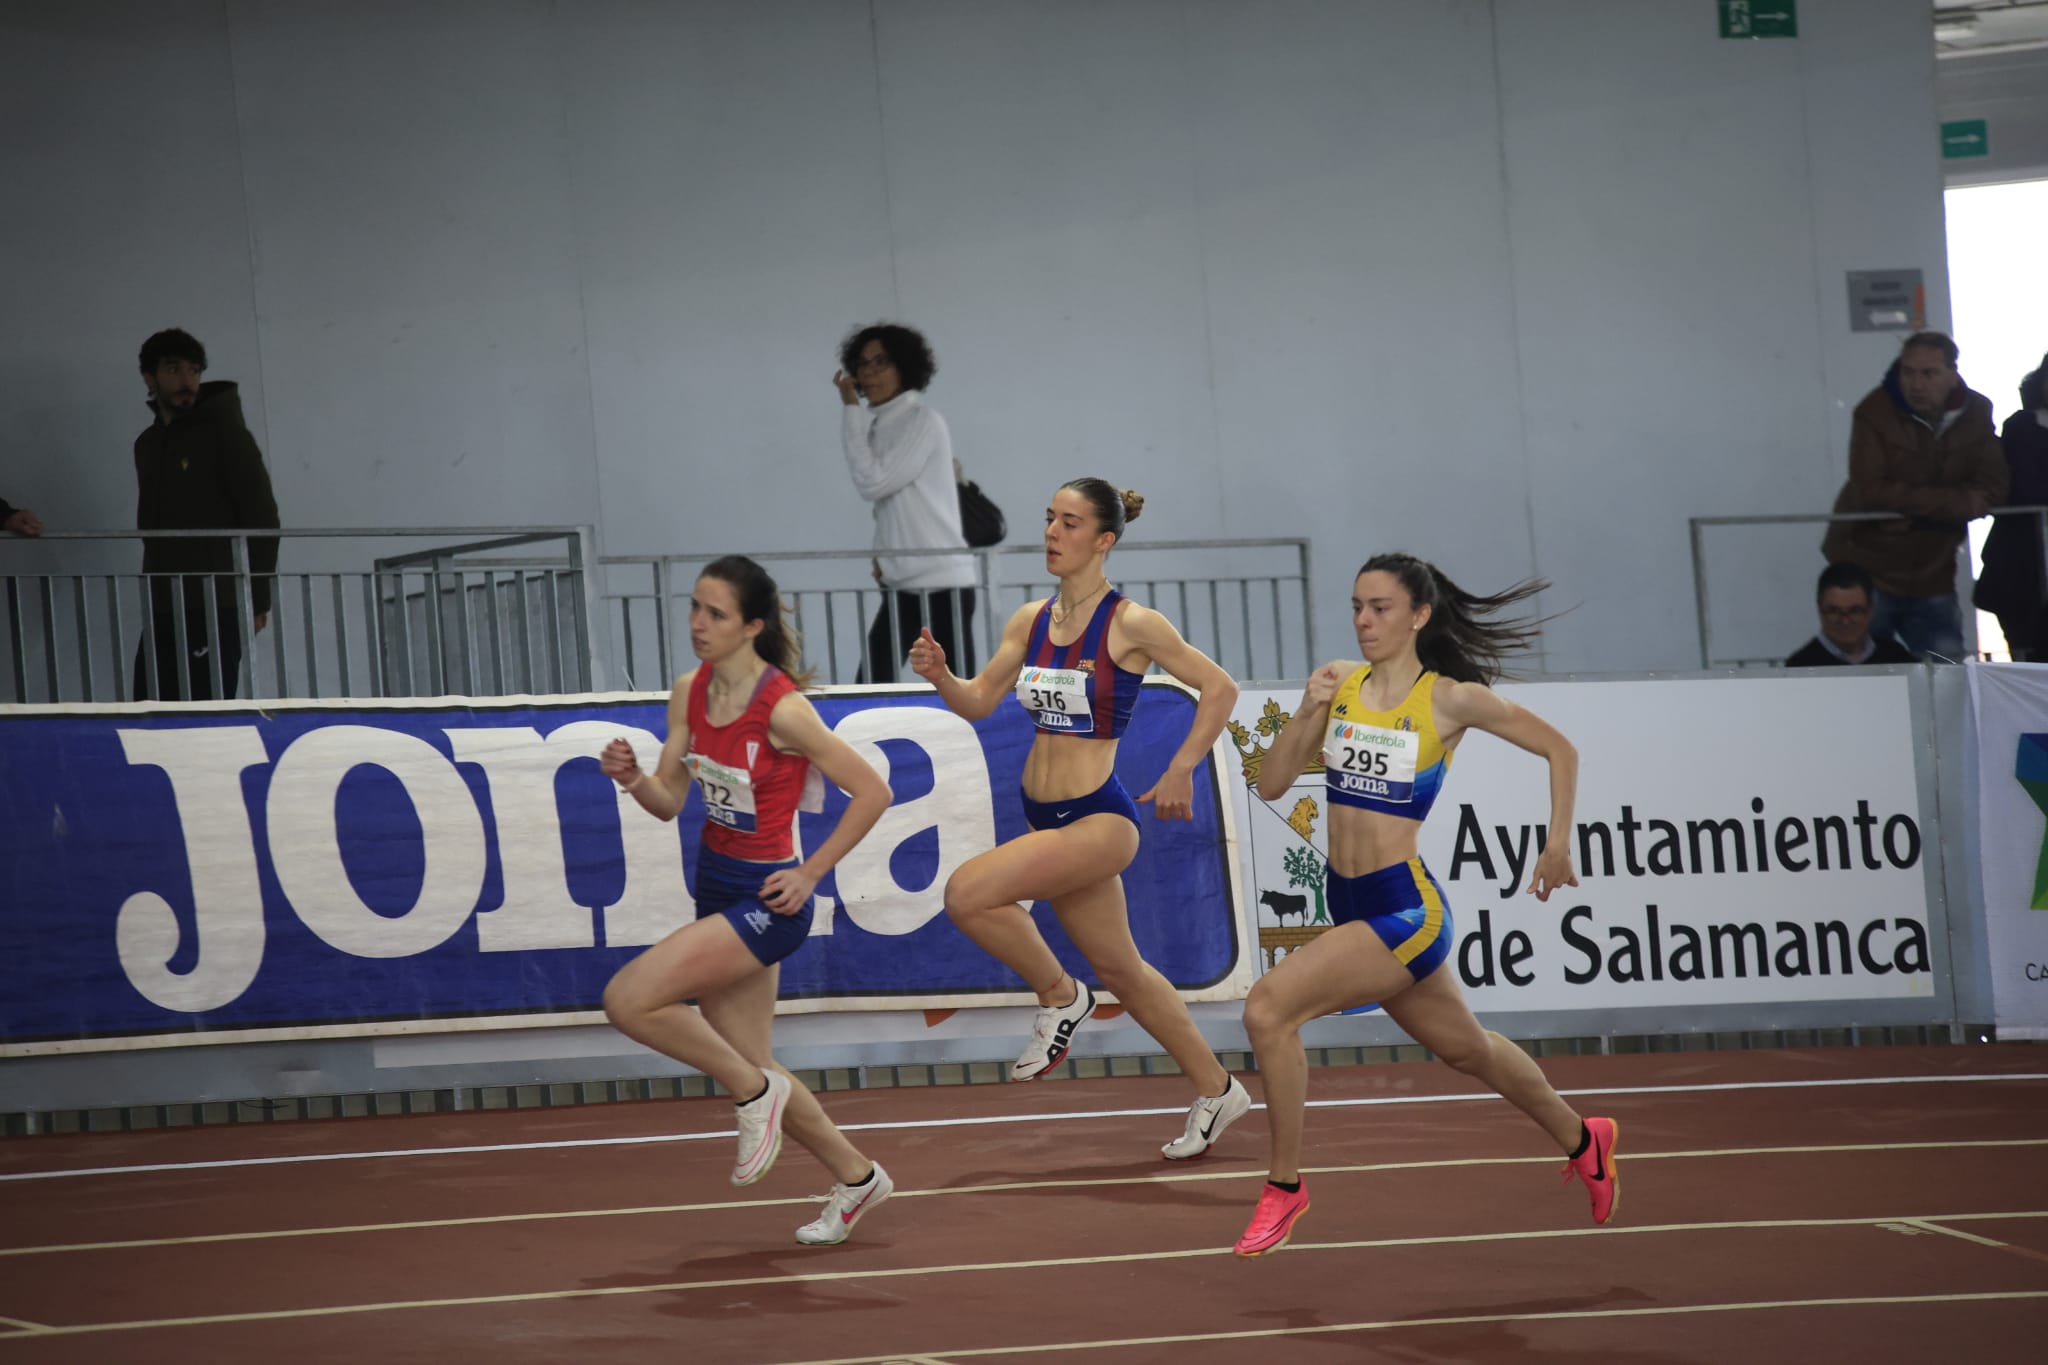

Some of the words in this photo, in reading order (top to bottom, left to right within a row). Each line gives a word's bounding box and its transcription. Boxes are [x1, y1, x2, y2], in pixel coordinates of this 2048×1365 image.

[1030, 689, 1067, 711] 376
[1354, 729, 1406, 749] Iberdrola
[1342, 747, 1389, 776] 295
[1340, 774, 1390, 795] Joma
[1457, 909, 1537, 988] de
[1560, 904, 1932, 985] Salamanca
[1047, 1018, 1077, 1064] AIR
